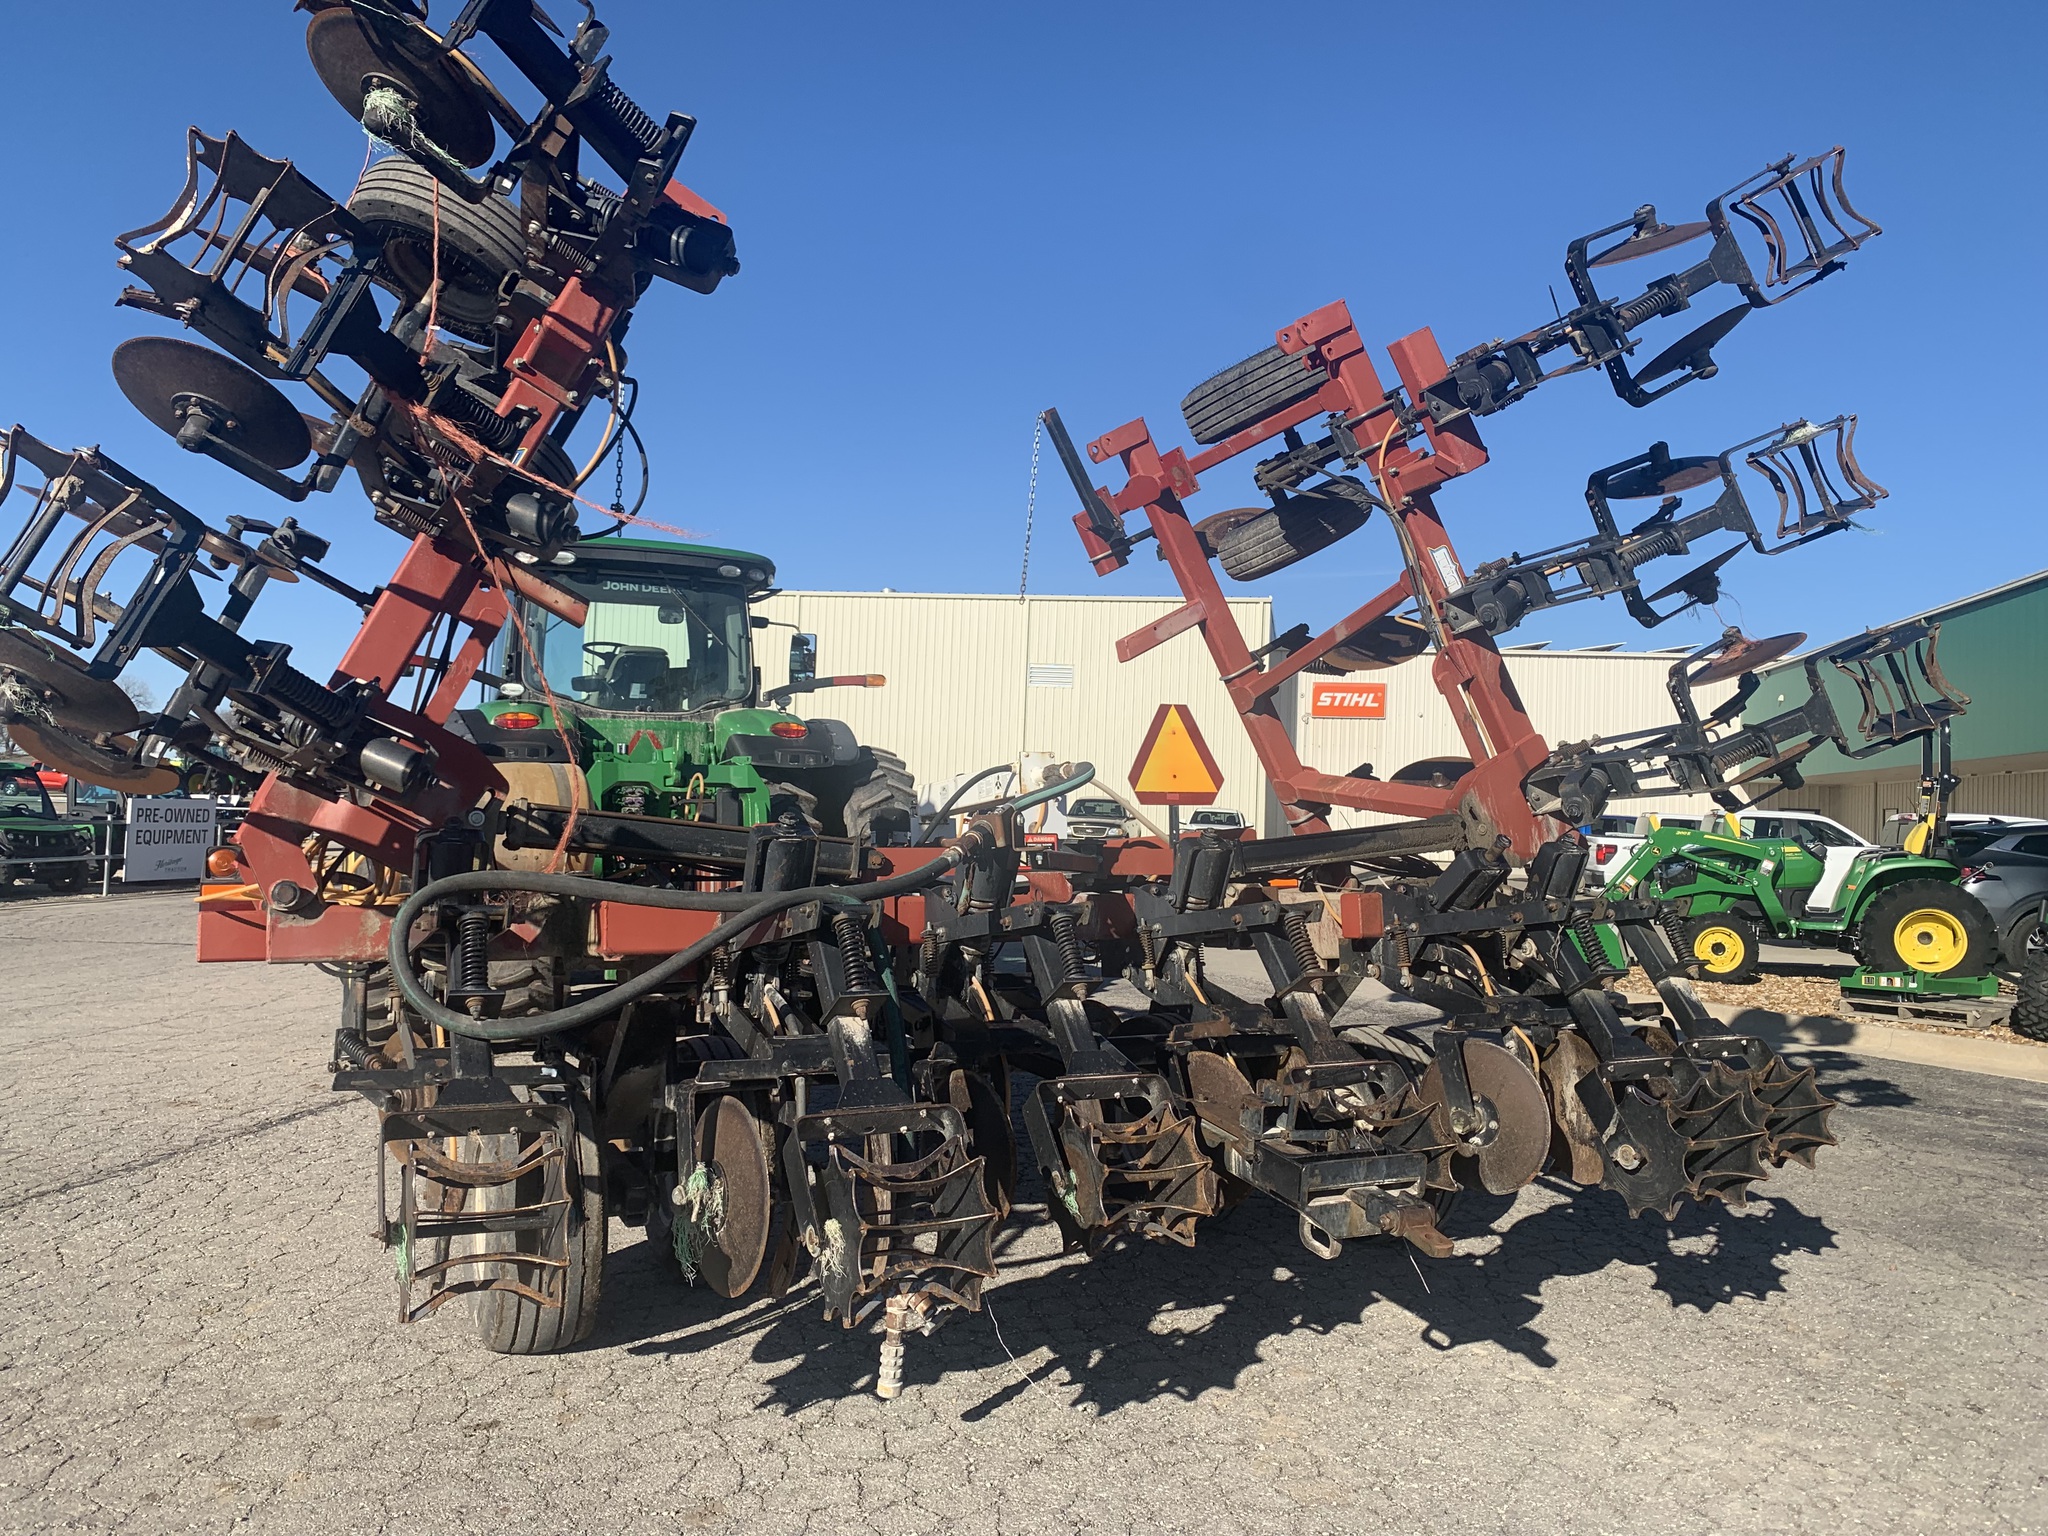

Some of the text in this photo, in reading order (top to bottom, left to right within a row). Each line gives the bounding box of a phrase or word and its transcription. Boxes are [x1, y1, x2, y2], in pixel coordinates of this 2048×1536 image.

[603, 581, 682, 594] JOHN DEE
[1316, 692, 1380, 707] STIHL
[136, 807, 210, 823] PRE-OWNED
[135, 829, 208, 846] EQUIPMENT
